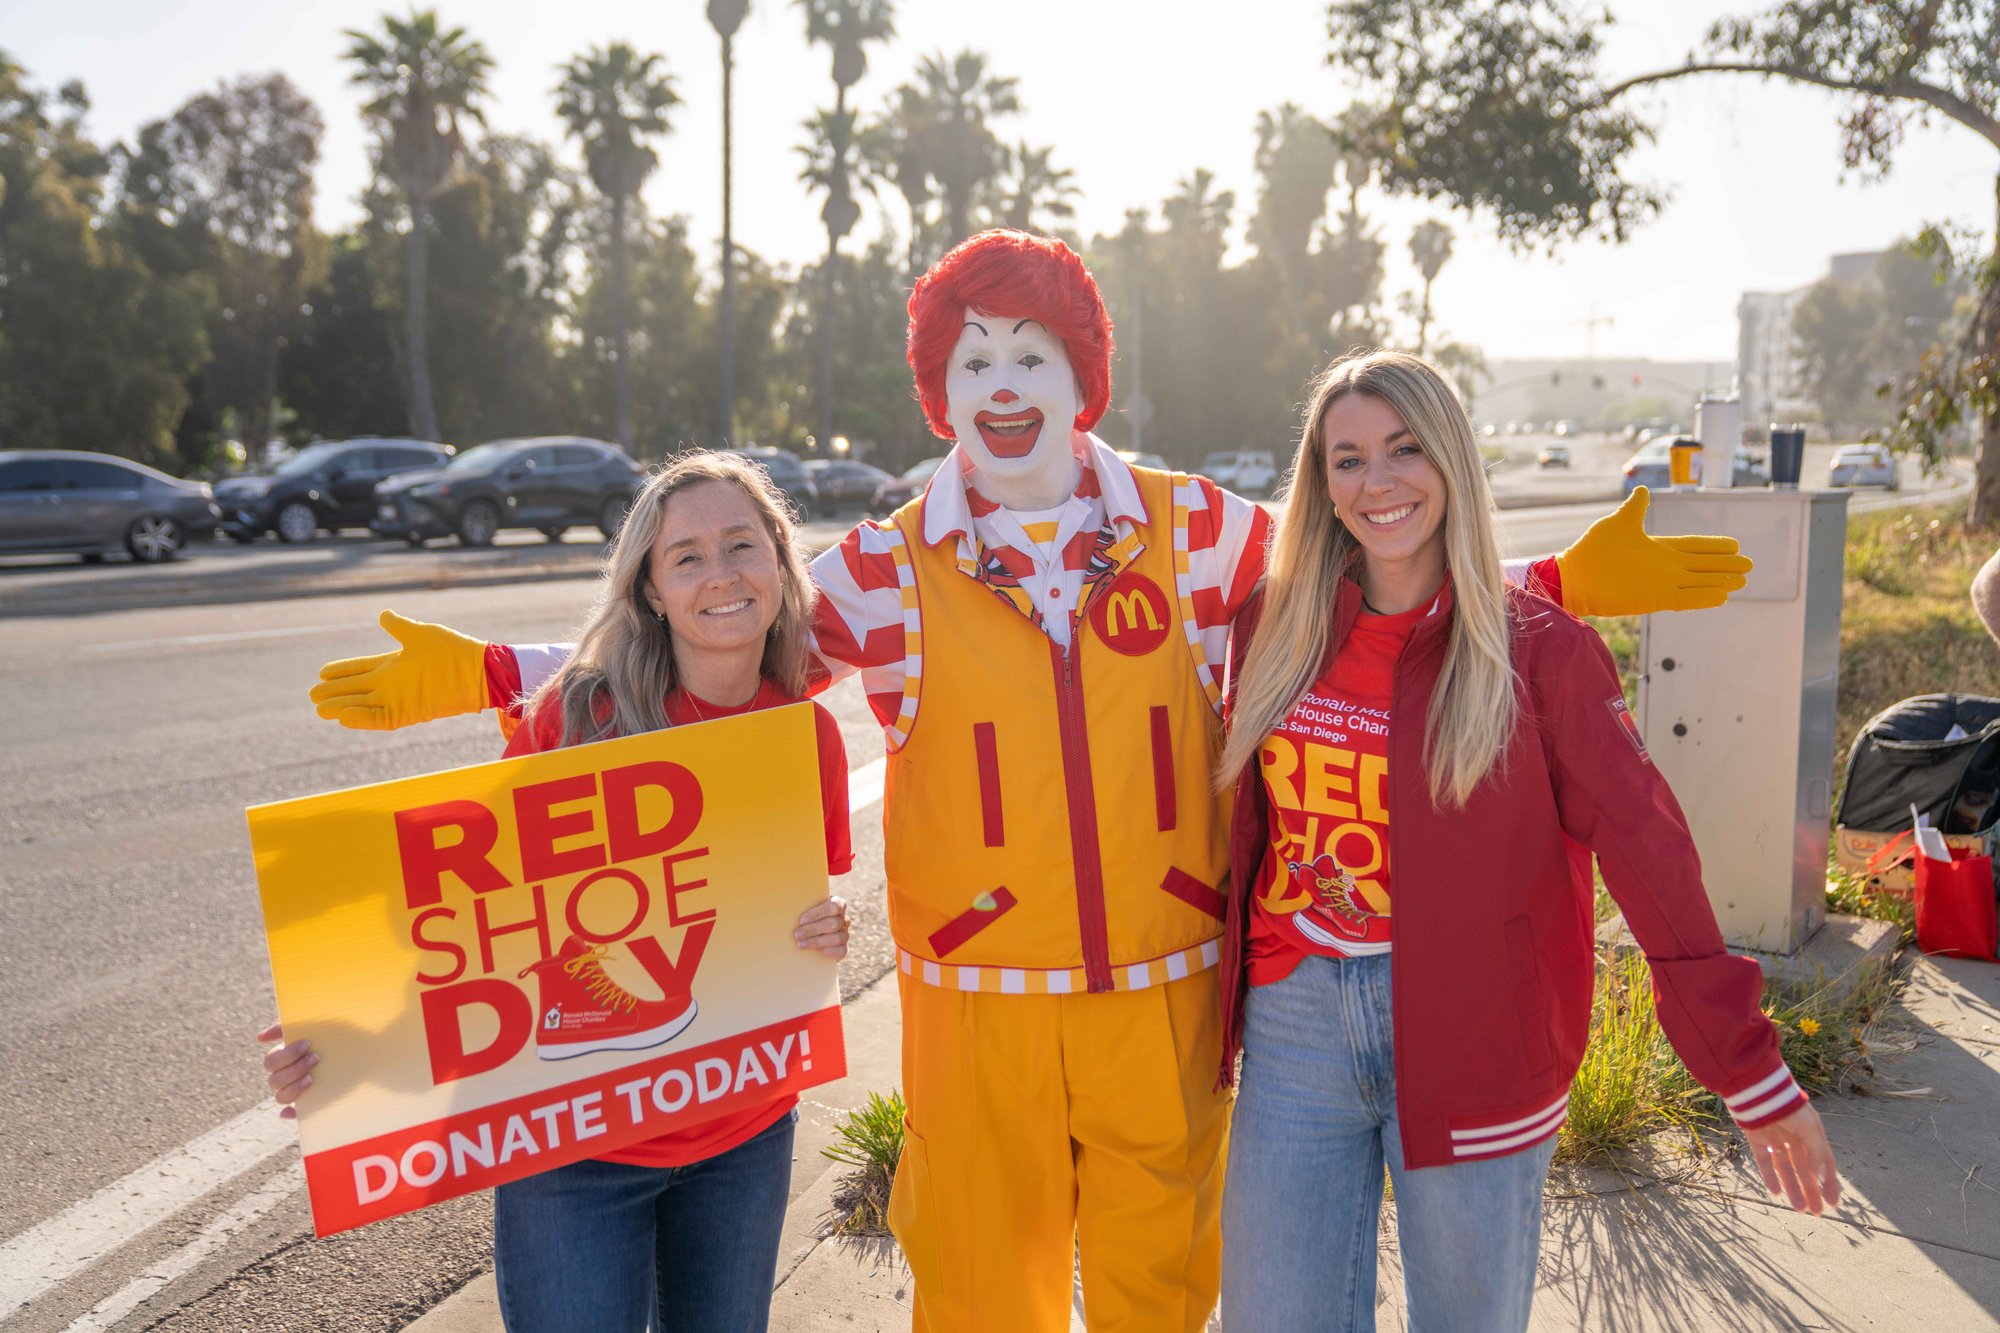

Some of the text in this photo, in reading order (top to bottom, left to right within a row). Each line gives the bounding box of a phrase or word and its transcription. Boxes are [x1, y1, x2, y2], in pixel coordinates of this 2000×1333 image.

[1289, 721, 1348, 743] San Diego
[1294, 704, 1344, 726] House
[1302, 693, 1357, 713] Ronald
[395, 760, 704, 909] RED
[411, 847, 717, 985] SHOE
[421, 919, 716, 1085] DY
[353, 1030, 813, 1205] DONATE TODAY!
